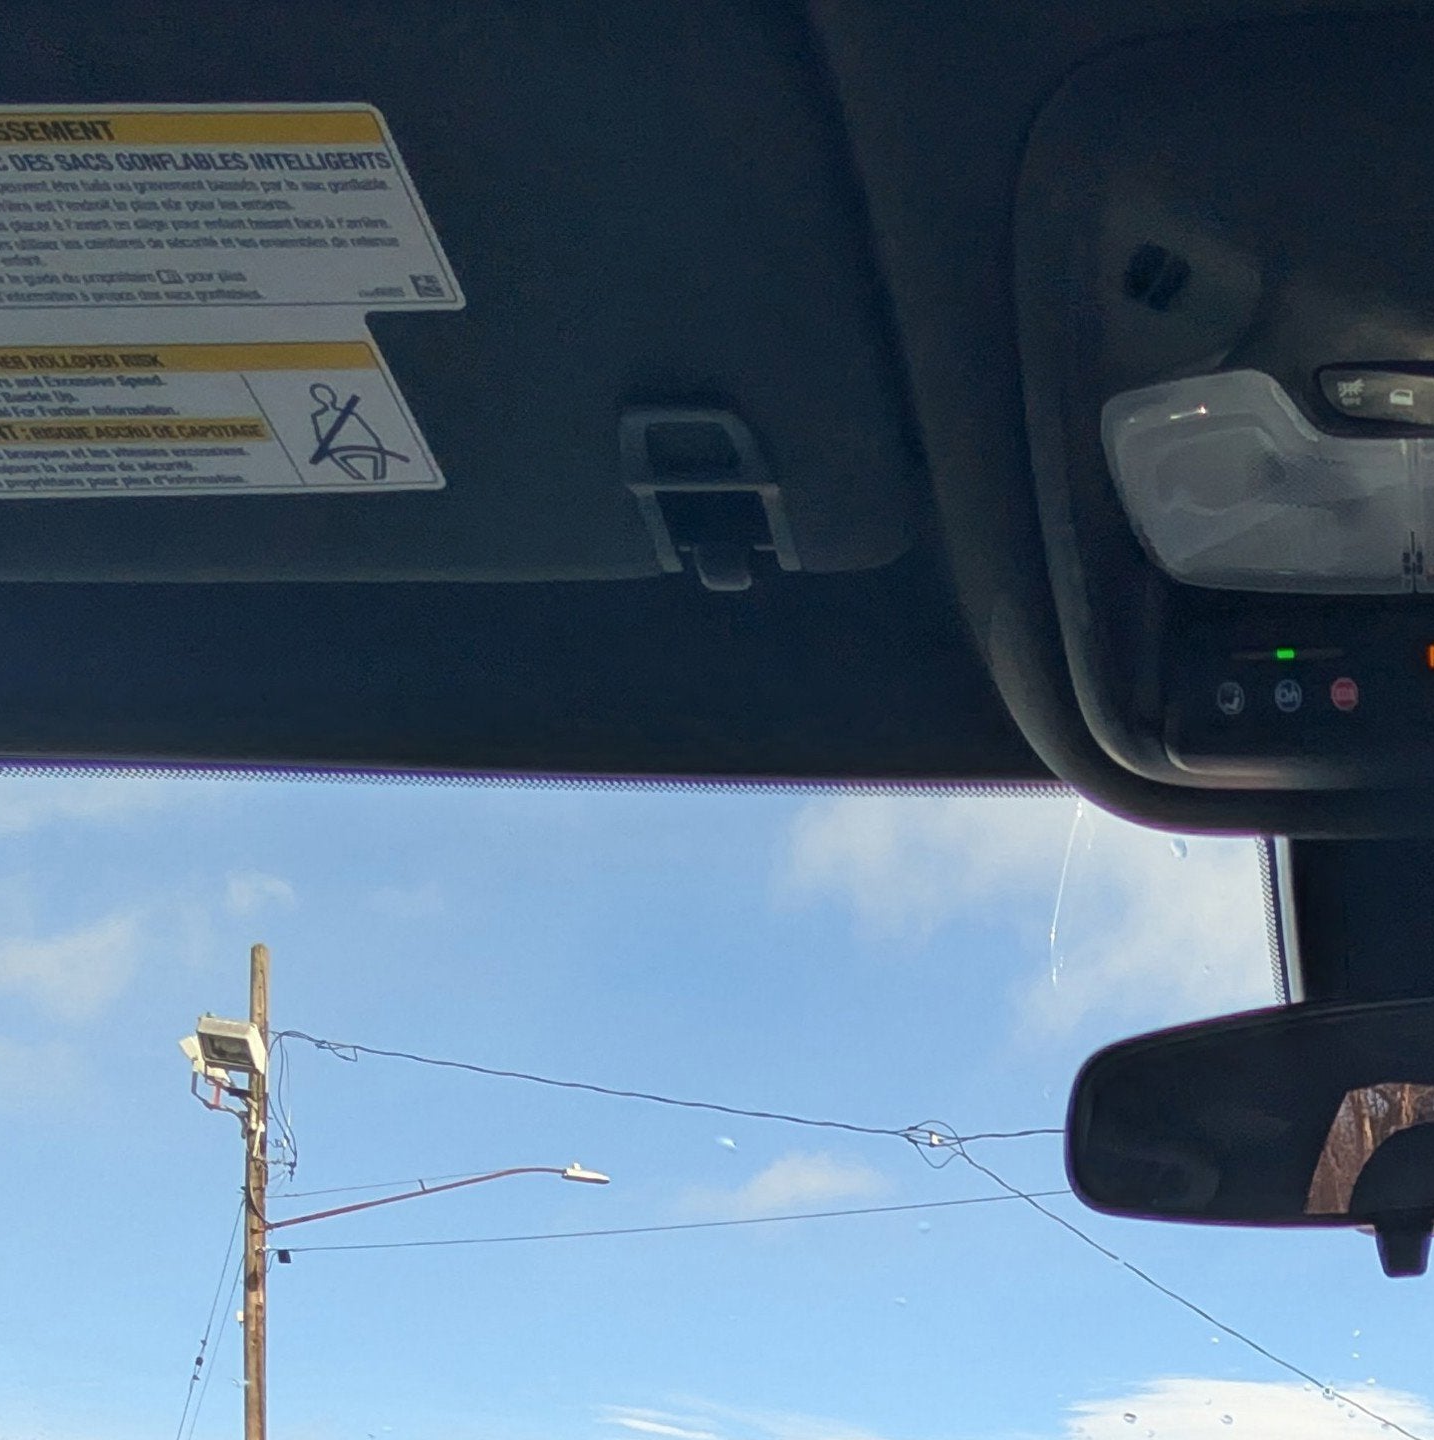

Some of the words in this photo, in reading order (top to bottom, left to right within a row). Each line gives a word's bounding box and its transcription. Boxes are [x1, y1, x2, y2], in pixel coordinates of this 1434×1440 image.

[9, 153, 55, 172] DES
[57, 153, 114, 171] SACS
[116, 152, 248, 171] GONFLABLES
[249, 151, 392, 171] INTELLIGENTS
[29, 355, 121, 369] ROLLOVER
[120, 354, 167, 368] RISK
[31, 426, 96, 439] RISQUE
[96, 426, 152, 438] ACCRU
[152, 426, 179, 438] DE
[178, 425, 265, 438] CAPOTAGE
